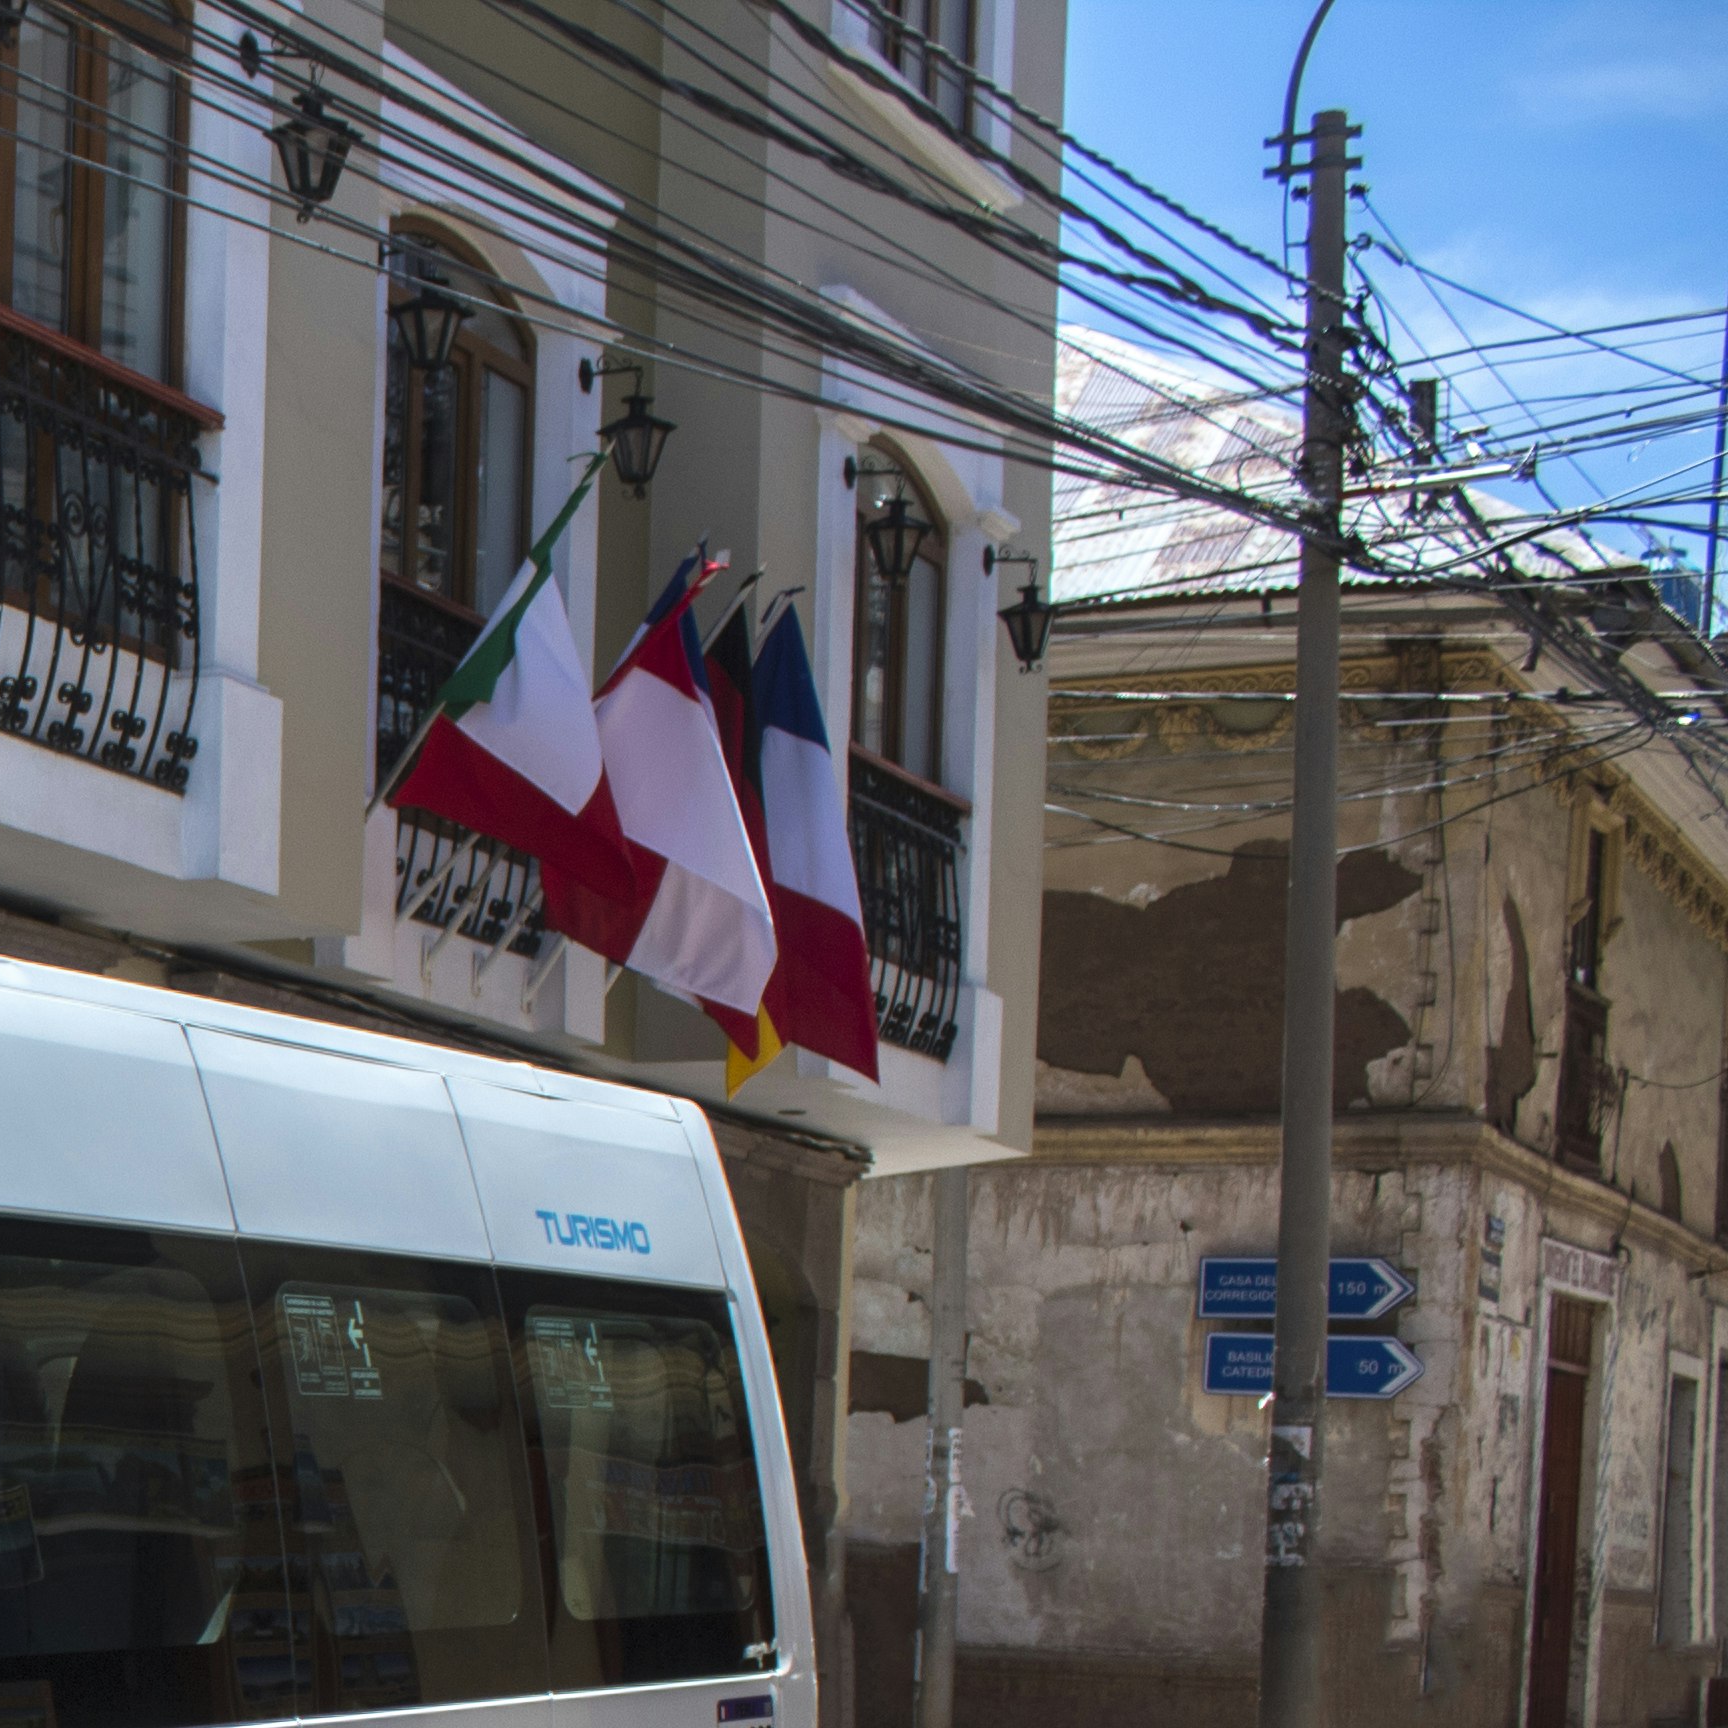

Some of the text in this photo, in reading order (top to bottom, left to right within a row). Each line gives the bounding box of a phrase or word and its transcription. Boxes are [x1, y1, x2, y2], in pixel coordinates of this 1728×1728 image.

[536, 1210, 651, 1255] TURISMO
[1219, 1274, 1277, 1287] CASA DEL
[1337, 1281, 1388, 1296] 150 m
[1204, 1289, 1277, 1302] CORREGIDO
[1228, 1350, 1274, 1363] BASILIC
[1222, 1366, 1274, 1378] CATEDR
[1358, 1360, 1403, 1375] 50 m
